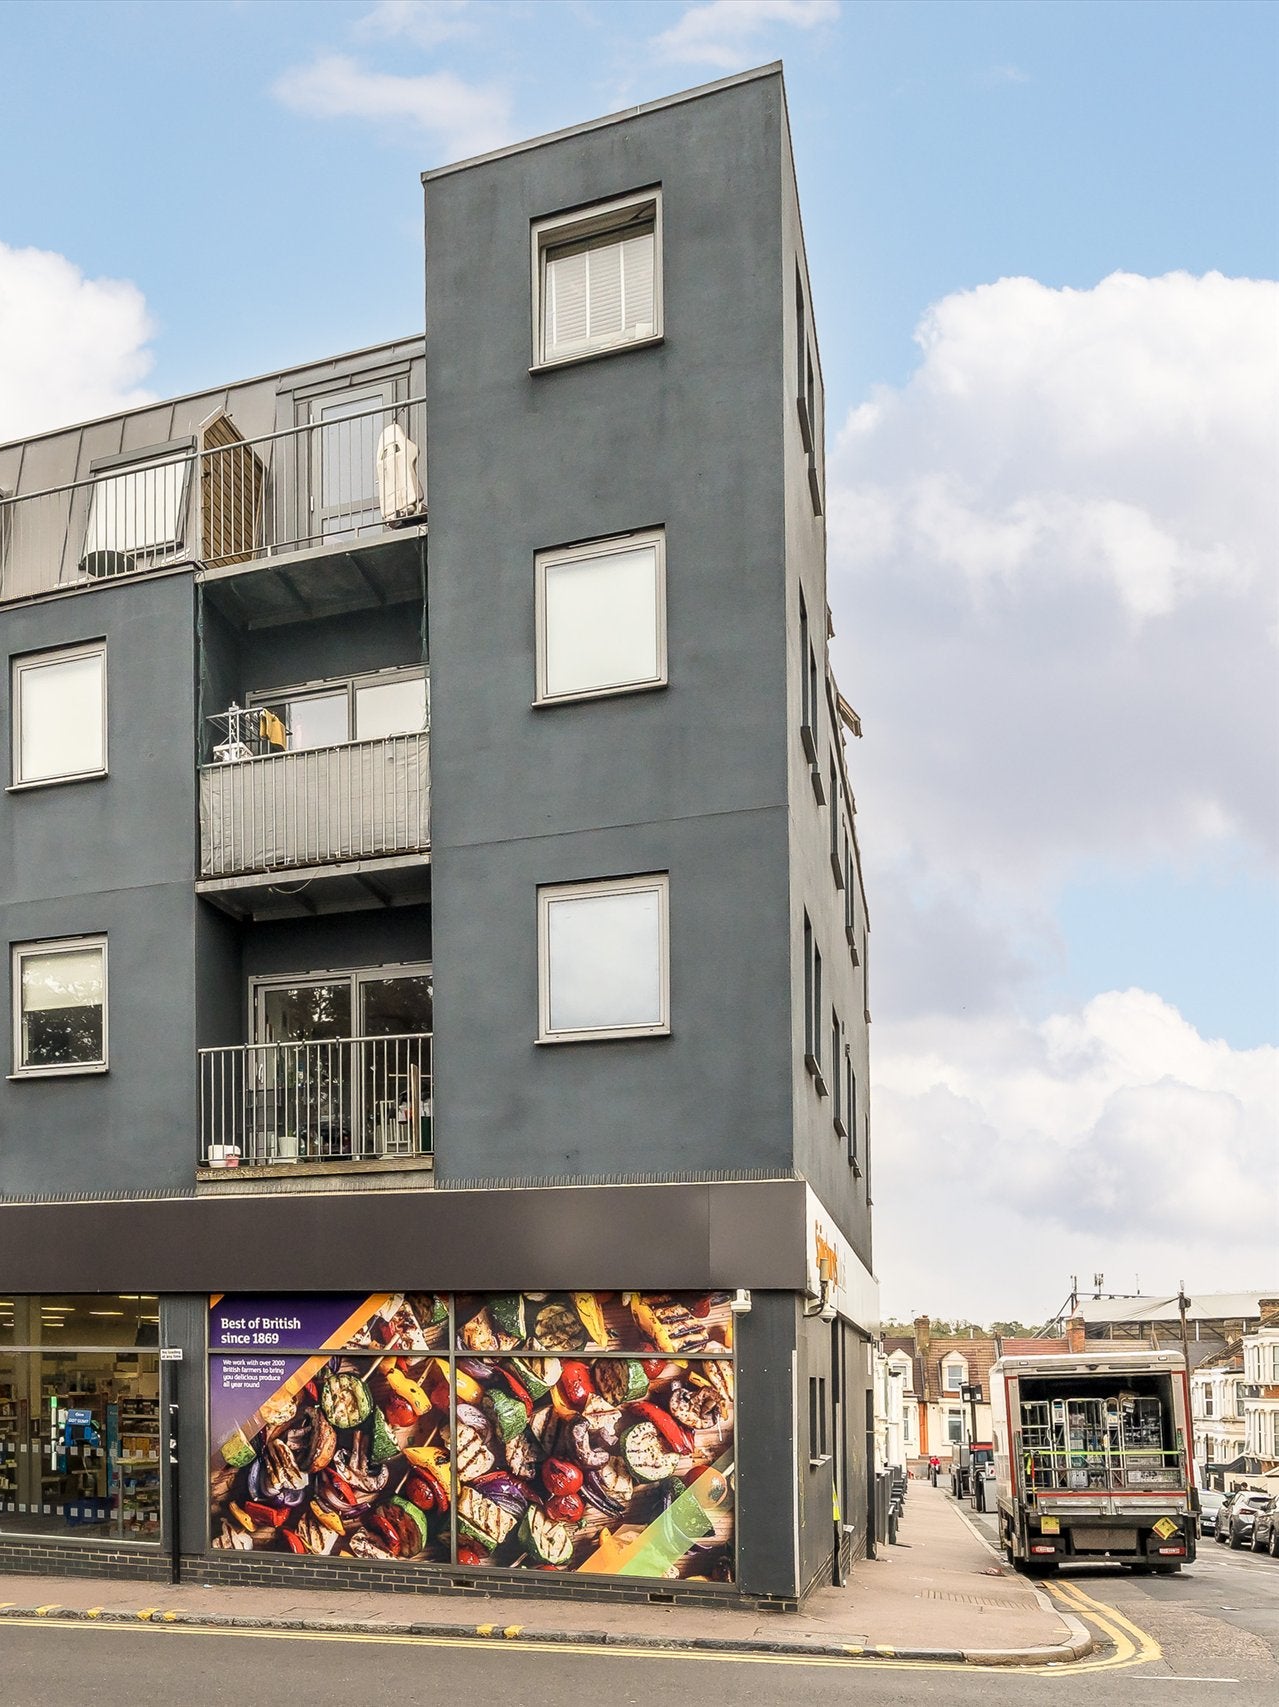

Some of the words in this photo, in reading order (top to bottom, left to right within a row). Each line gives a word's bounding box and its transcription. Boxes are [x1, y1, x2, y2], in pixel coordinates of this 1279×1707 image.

[221, 1317, 246, 1329] Best
[248, 1317, 261, 1329] of
[262, 1317, 301, 1330] British
[221, 1332, 251, 1344] since
[252, 1333, 280, 1344] 1869
[269, 1367, 285, 1375] bring
